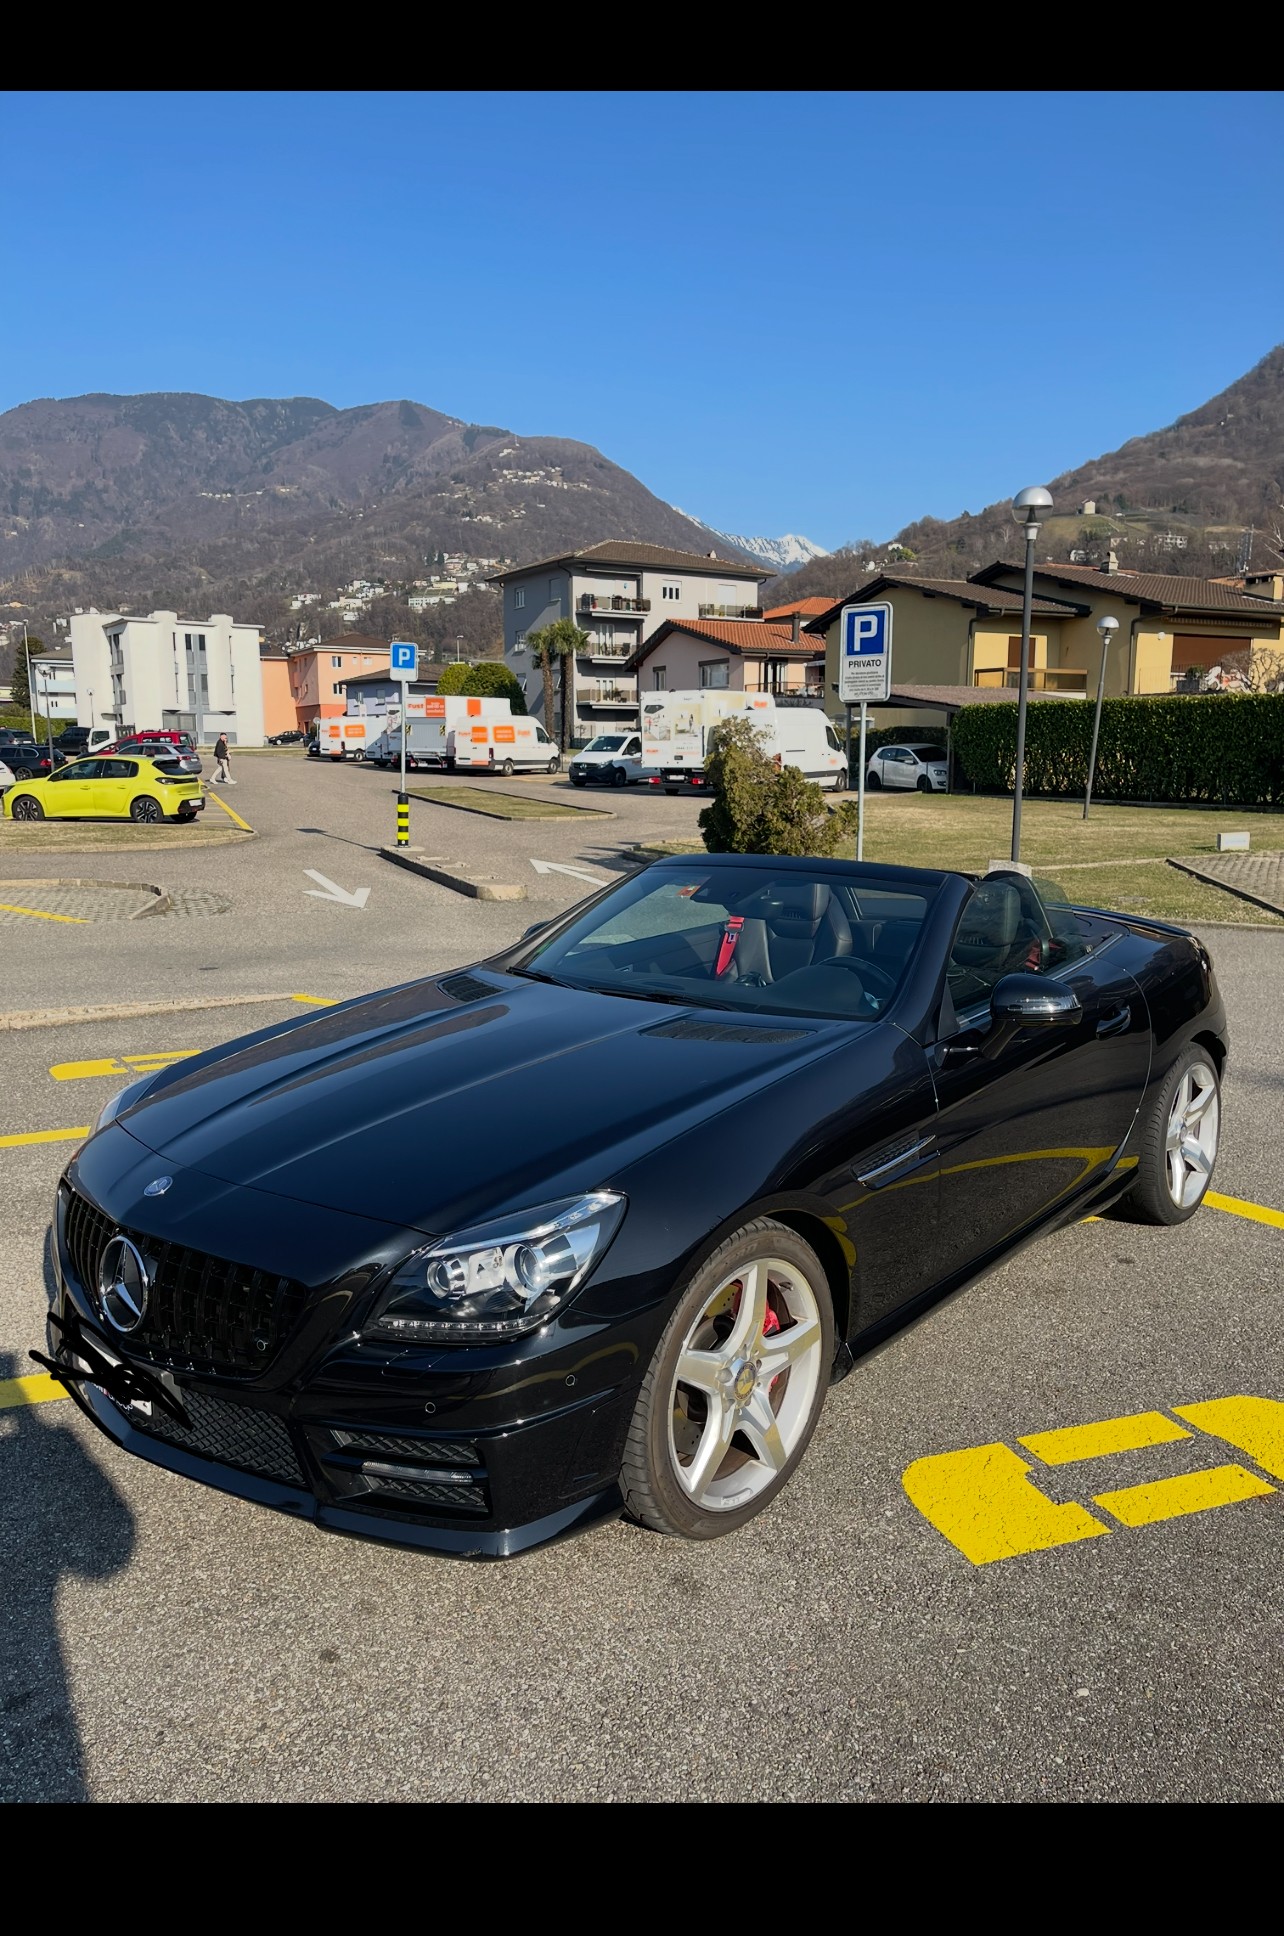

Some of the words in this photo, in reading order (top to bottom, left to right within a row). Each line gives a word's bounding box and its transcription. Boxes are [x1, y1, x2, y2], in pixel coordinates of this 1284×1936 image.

[854, 614, 878, 652] P
[398, 647, 411, 666] P
[848, 659, 882, 668] PRIVATO
